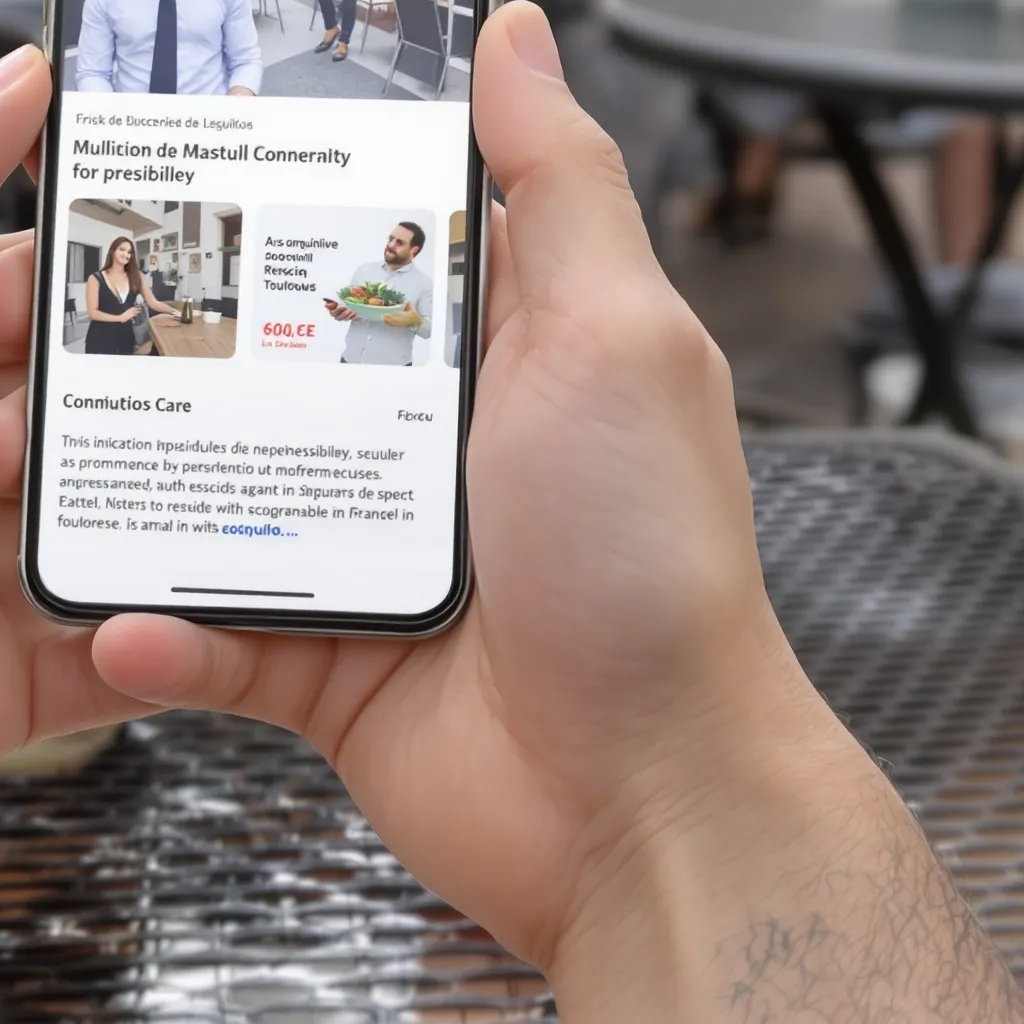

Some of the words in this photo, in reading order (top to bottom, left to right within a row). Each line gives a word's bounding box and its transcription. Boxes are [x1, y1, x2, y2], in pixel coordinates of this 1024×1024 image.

[157, 143, 177, 158] de
[182, 143, 249, 162] Mastull
[72, 162, 100, 180] for
[155, 397, 192, 413] Care
[60, 458, 75, 467] as
[164, 459, 178, 474] by
[258, 465, 271, 475] ut
[283, 484, 294, 496] in
[358, 487, 374, 500] de
[377, 489, 414, 503] spect
[151, 501, 163, 511] to
[215, 501, 244, 516] with
[403, 509, 414, 520] in
[177, 520, 188, 532] in
